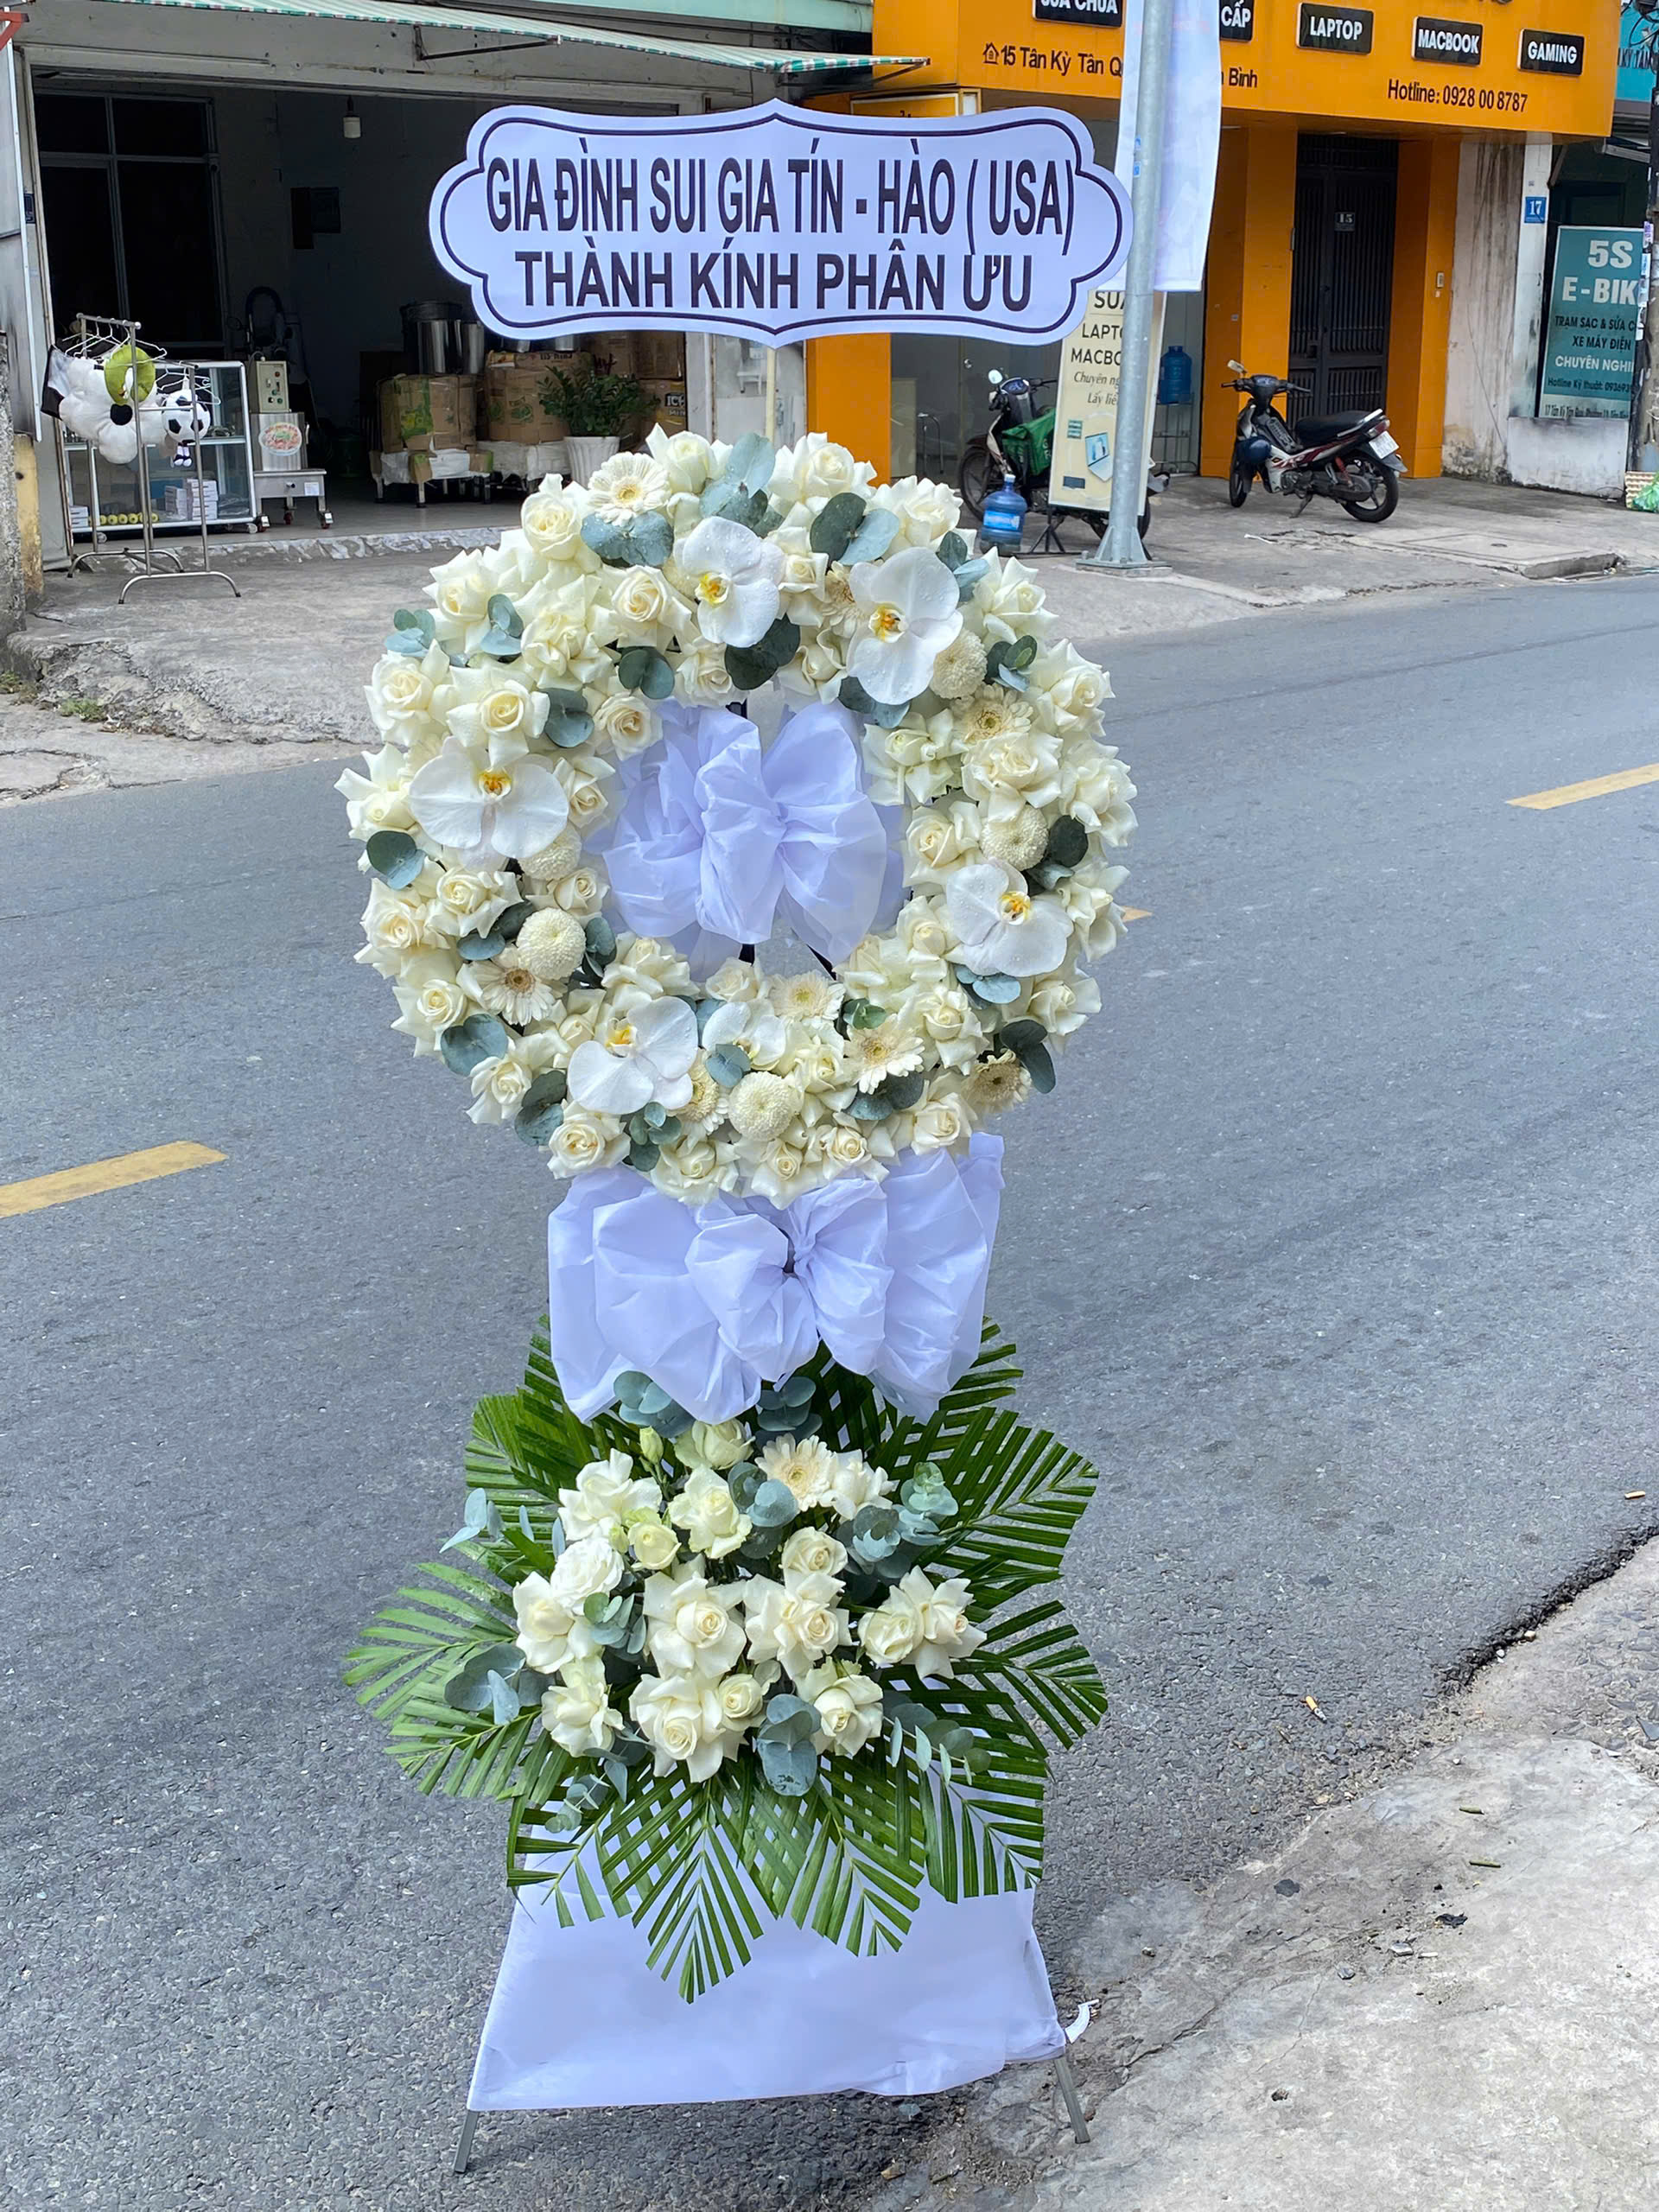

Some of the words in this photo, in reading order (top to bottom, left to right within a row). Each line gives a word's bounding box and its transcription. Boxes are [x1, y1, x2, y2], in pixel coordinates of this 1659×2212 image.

[1221, 0, 1251, 28] CẤP
[1310, 16, 1363, 41] LAPTOP
[1418, 29, 1480, 54] MACBOOK
[1528, 41, 1577, 65] GAMING
[1001, 46, 1016, 66] 15
[1020, 47, 1046, 69] Tân
[1051, 50, 1071, 76] Kỳ
[1078, 53, 1103, 74] Tân
[1109, 56, 1122, 77] Q
[1229, 67, 1258, 88] Bình
[1388, 79, 1440, 104] Hotline:
[1443, 85, 1475, 107] 0928
[1478, 89, 1495, 110] 00
[1497, 90, 1528, 112] 8787
[486, 157, 548, 232] GIA
[554, 137, 637, 232] ĐÌNH
[650, 157, 707, 233] SUI
[717, 158, 778, 233] GIA
[788, 138, 843, 233] TÍN
[879, 138, 954, 237] HÀO
[1340, 213, 1353, 223] 15
[1529, 200, 1542, 215] 17
[1588, 240, 1633, 269] 5S
[515, 238, 673, 308] THÀNH
[690, 237, 798, 310] KÍNH
[817, 238, 944, 311] PHÂN
[963, 254, 1032, 312] ƯU
[1082, 322, 1122, 340] LAPT
[1555, 315, 1578, 329] TRẠM
[1580, 317, 1599, 331] SẠC
[1573, 335, 1584, 346] XE
[1586, 334, 1607, 349] MÁY
[1610, 336, 1631, 353] ĐIỆN
[1555, 355, 1599, 370] CHUYÊN
[1074, 371, 1108, 387] Chuyên
